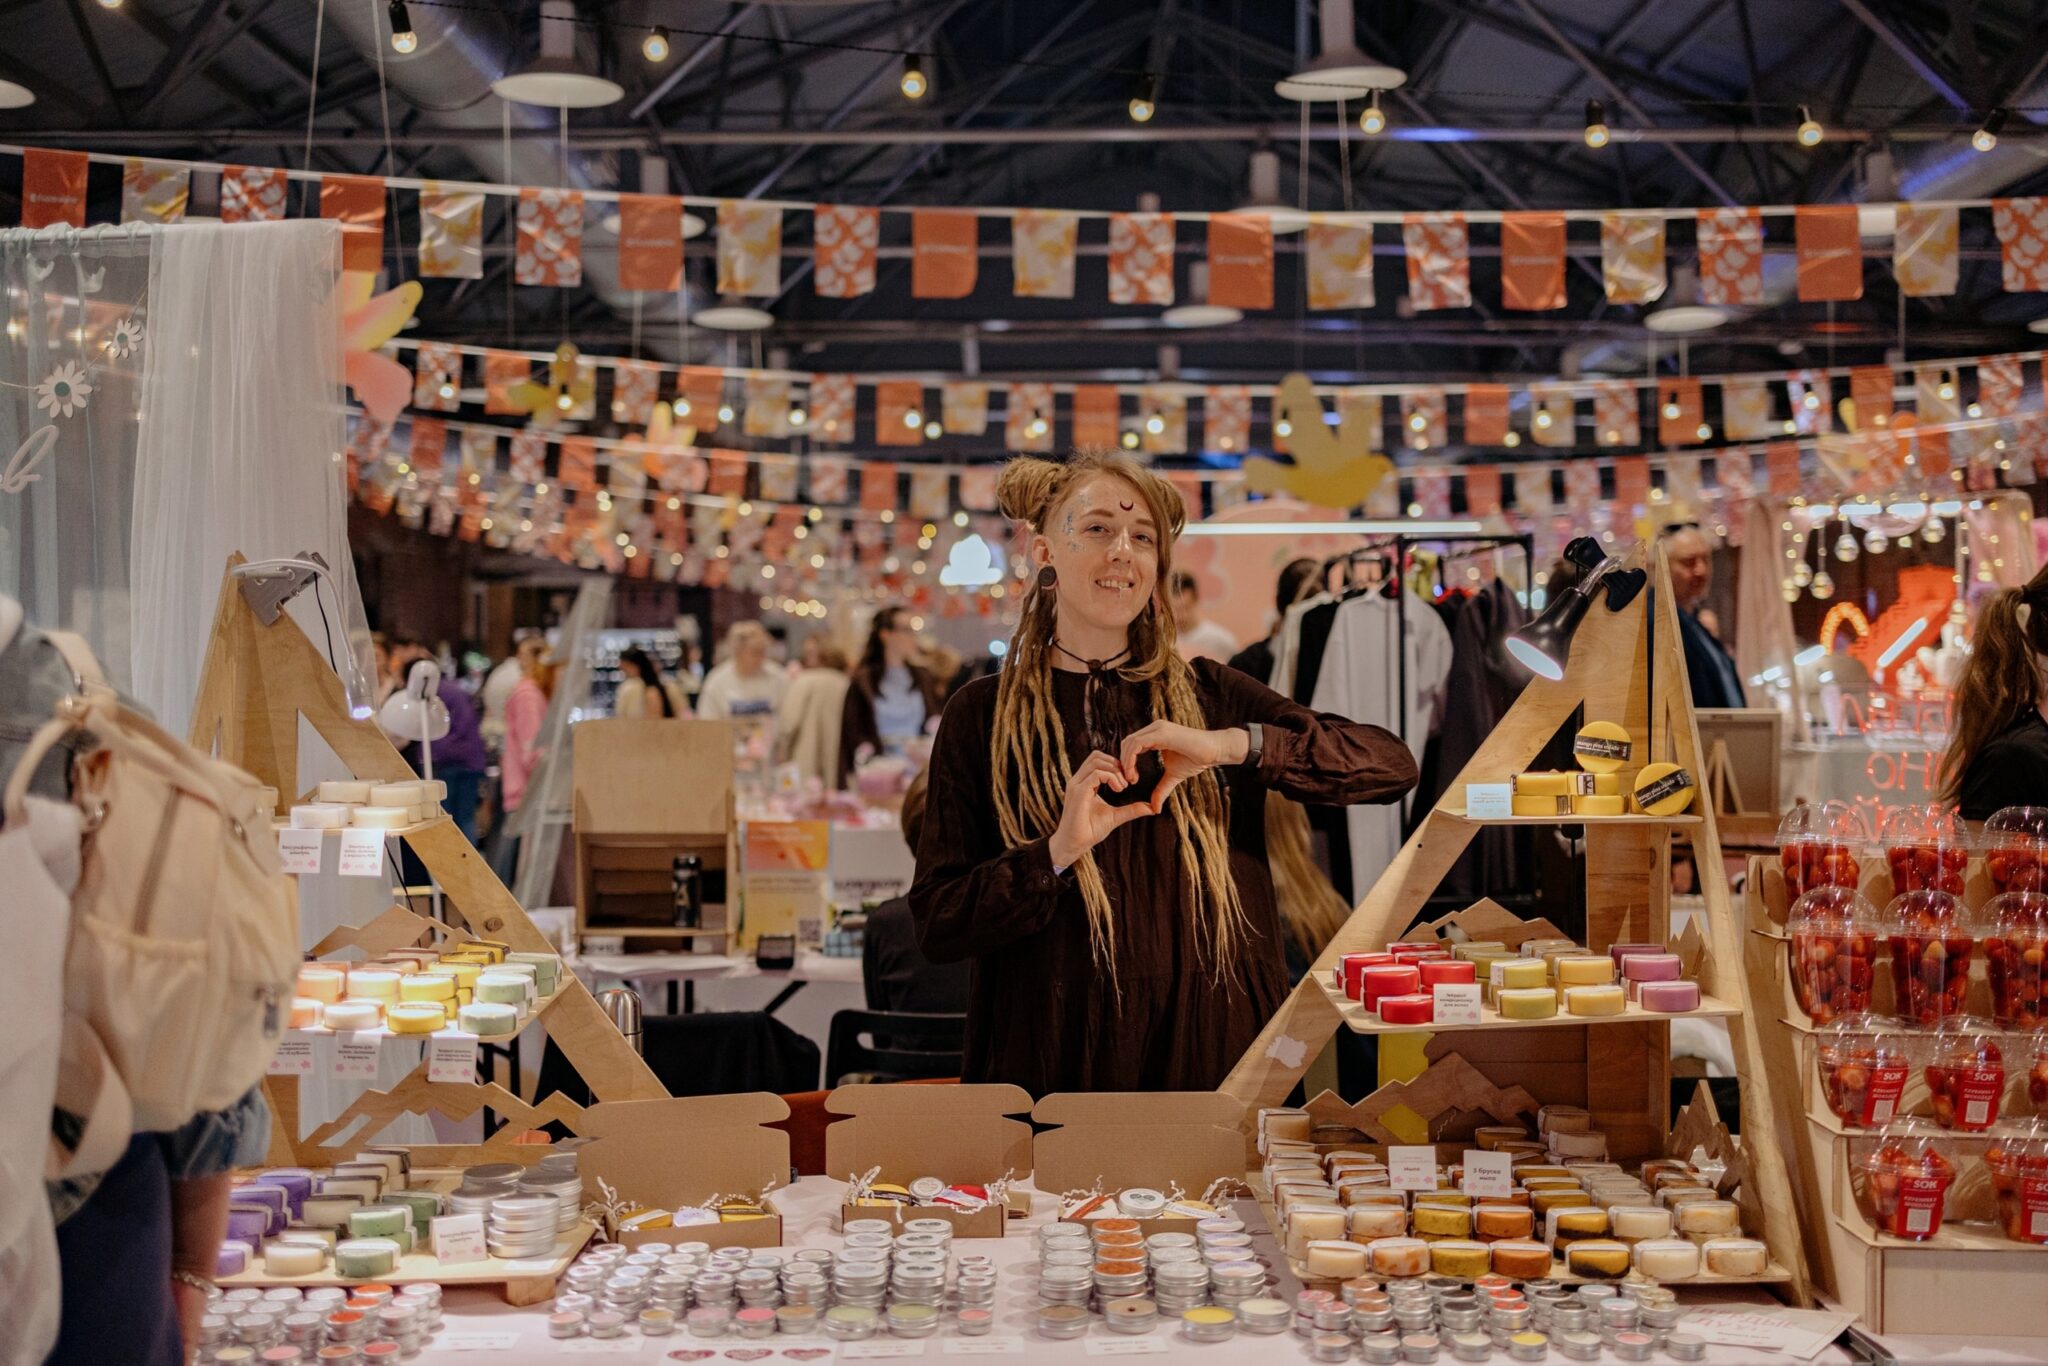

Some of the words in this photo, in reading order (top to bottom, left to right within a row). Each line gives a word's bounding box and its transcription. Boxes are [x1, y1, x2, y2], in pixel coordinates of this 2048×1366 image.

[1882, 1071, 1904, 1081] SOK
[1974, 1071, 1998, 1081] SOK
[1912, 1179, 1939, 1189] SOK
